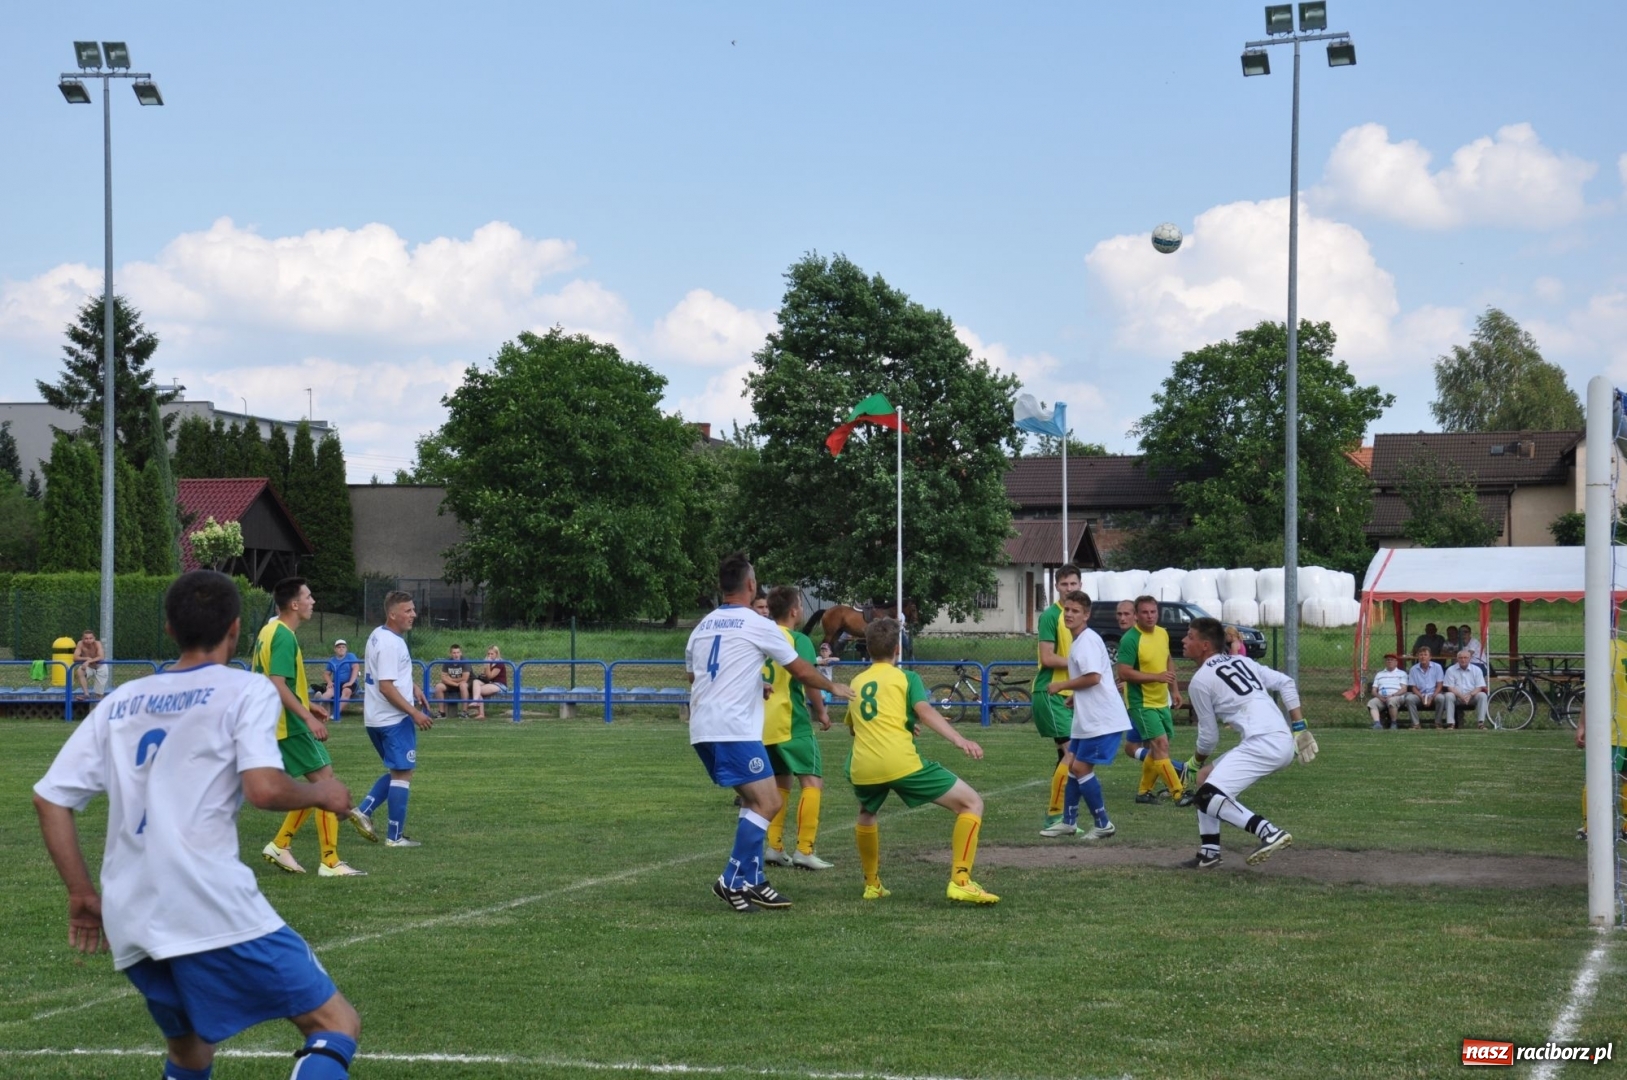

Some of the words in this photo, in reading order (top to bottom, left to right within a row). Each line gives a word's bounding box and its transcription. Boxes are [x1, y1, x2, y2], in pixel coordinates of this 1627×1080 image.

[707, 634, 722, 682] 4
[1215, 659, 1263, 696] 69
[108, 698, 130, 720] LKS
[129, 694, 145, 716] 07
[859, 681, 878, 722] 8
